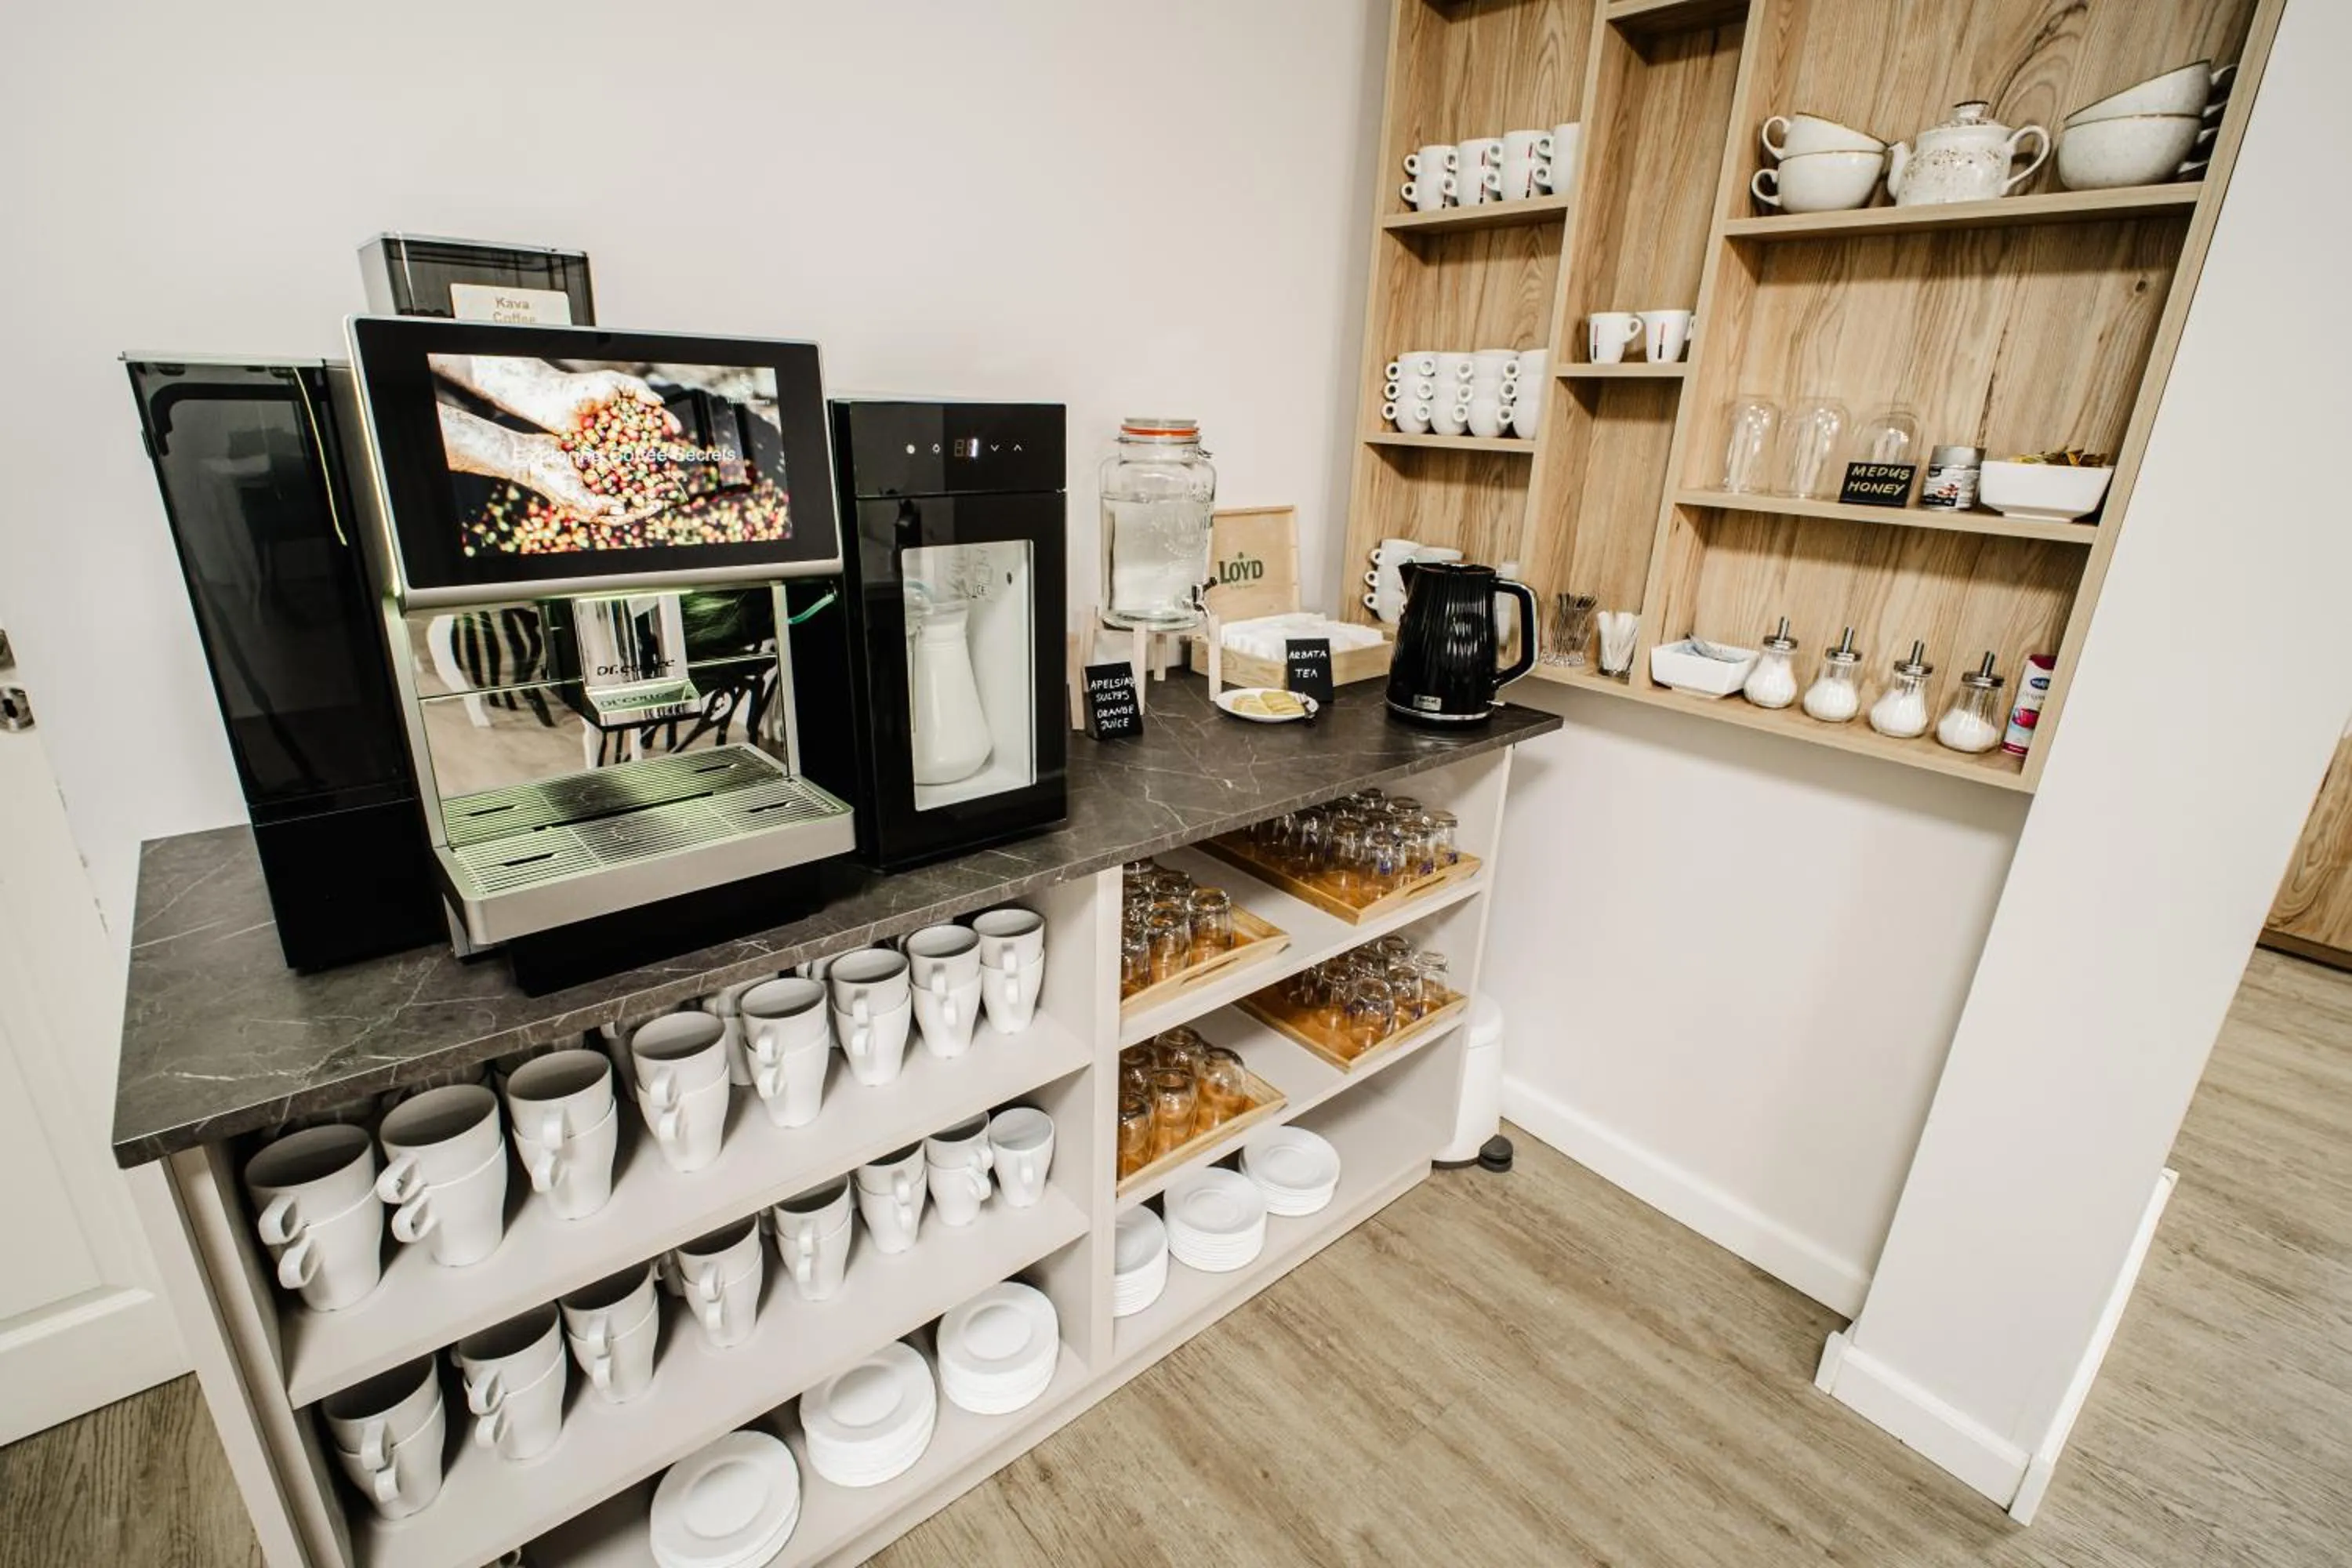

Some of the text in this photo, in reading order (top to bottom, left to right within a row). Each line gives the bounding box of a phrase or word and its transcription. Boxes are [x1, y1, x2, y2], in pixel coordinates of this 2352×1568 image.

[495, 296, 530, 309] Kava
[492, 312, 536, 324] Coffee
[612, 448, 668, 462] Coffee
[675, 448, 736, 462] Secrets
[1851, 465, 1910, 481] MEDUS
[1847, 481, 1906, 496] HONEY
[1218, 559, 1264, 584] LOYD
[1288, 650, 1327, 659] ARBATA
[1294, 668, 1318, 678] TEA
[1097, 704, 1134, 718] ORANGE
[1101, 717, 1129, 731] JUICE
